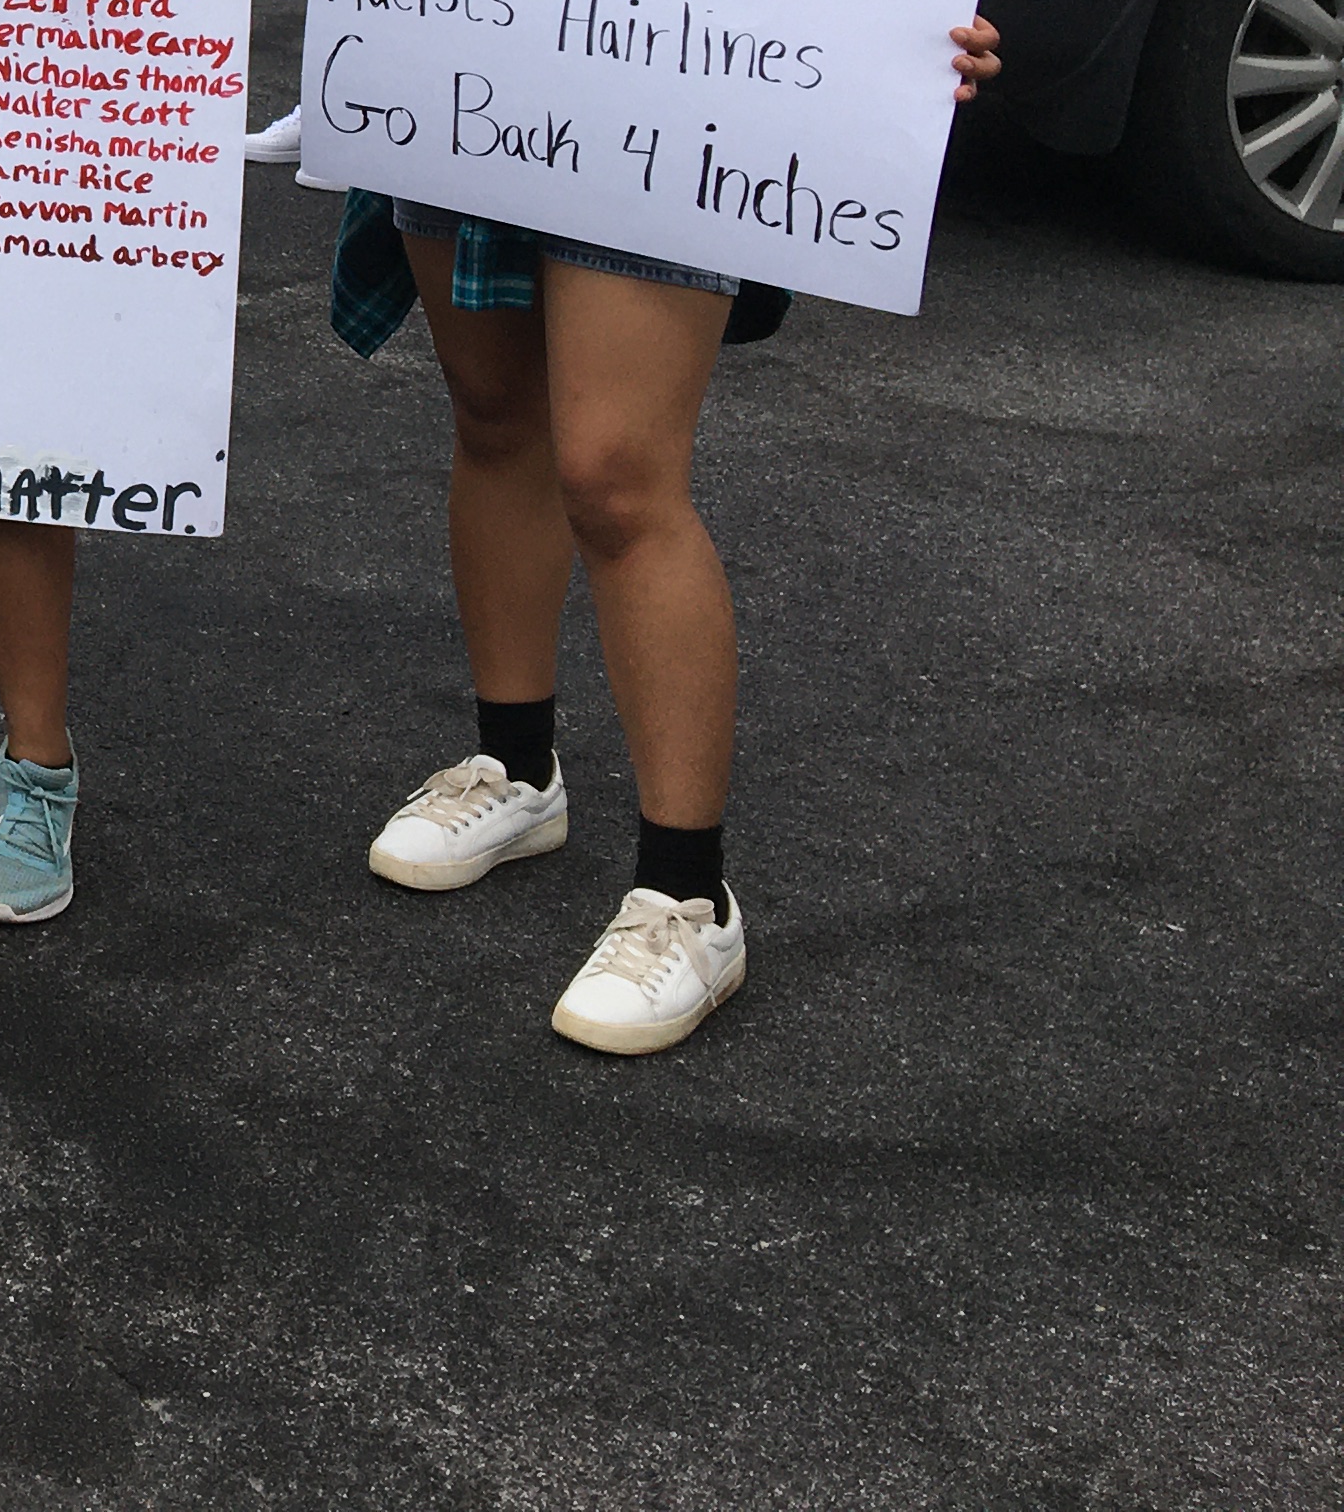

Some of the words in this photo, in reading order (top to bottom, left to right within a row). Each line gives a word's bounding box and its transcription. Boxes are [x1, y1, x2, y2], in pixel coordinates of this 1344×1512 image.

[137, 64, 244, 99] thomas
[322, 35, 418, 146] Go
[452, 73, 580, 173] Back
[622, 125, 660, 192] 4
[696, 123, 904, 250] inches
[80, 163, 154, 194] Rice
[103, 200, 207, 230] Martin
